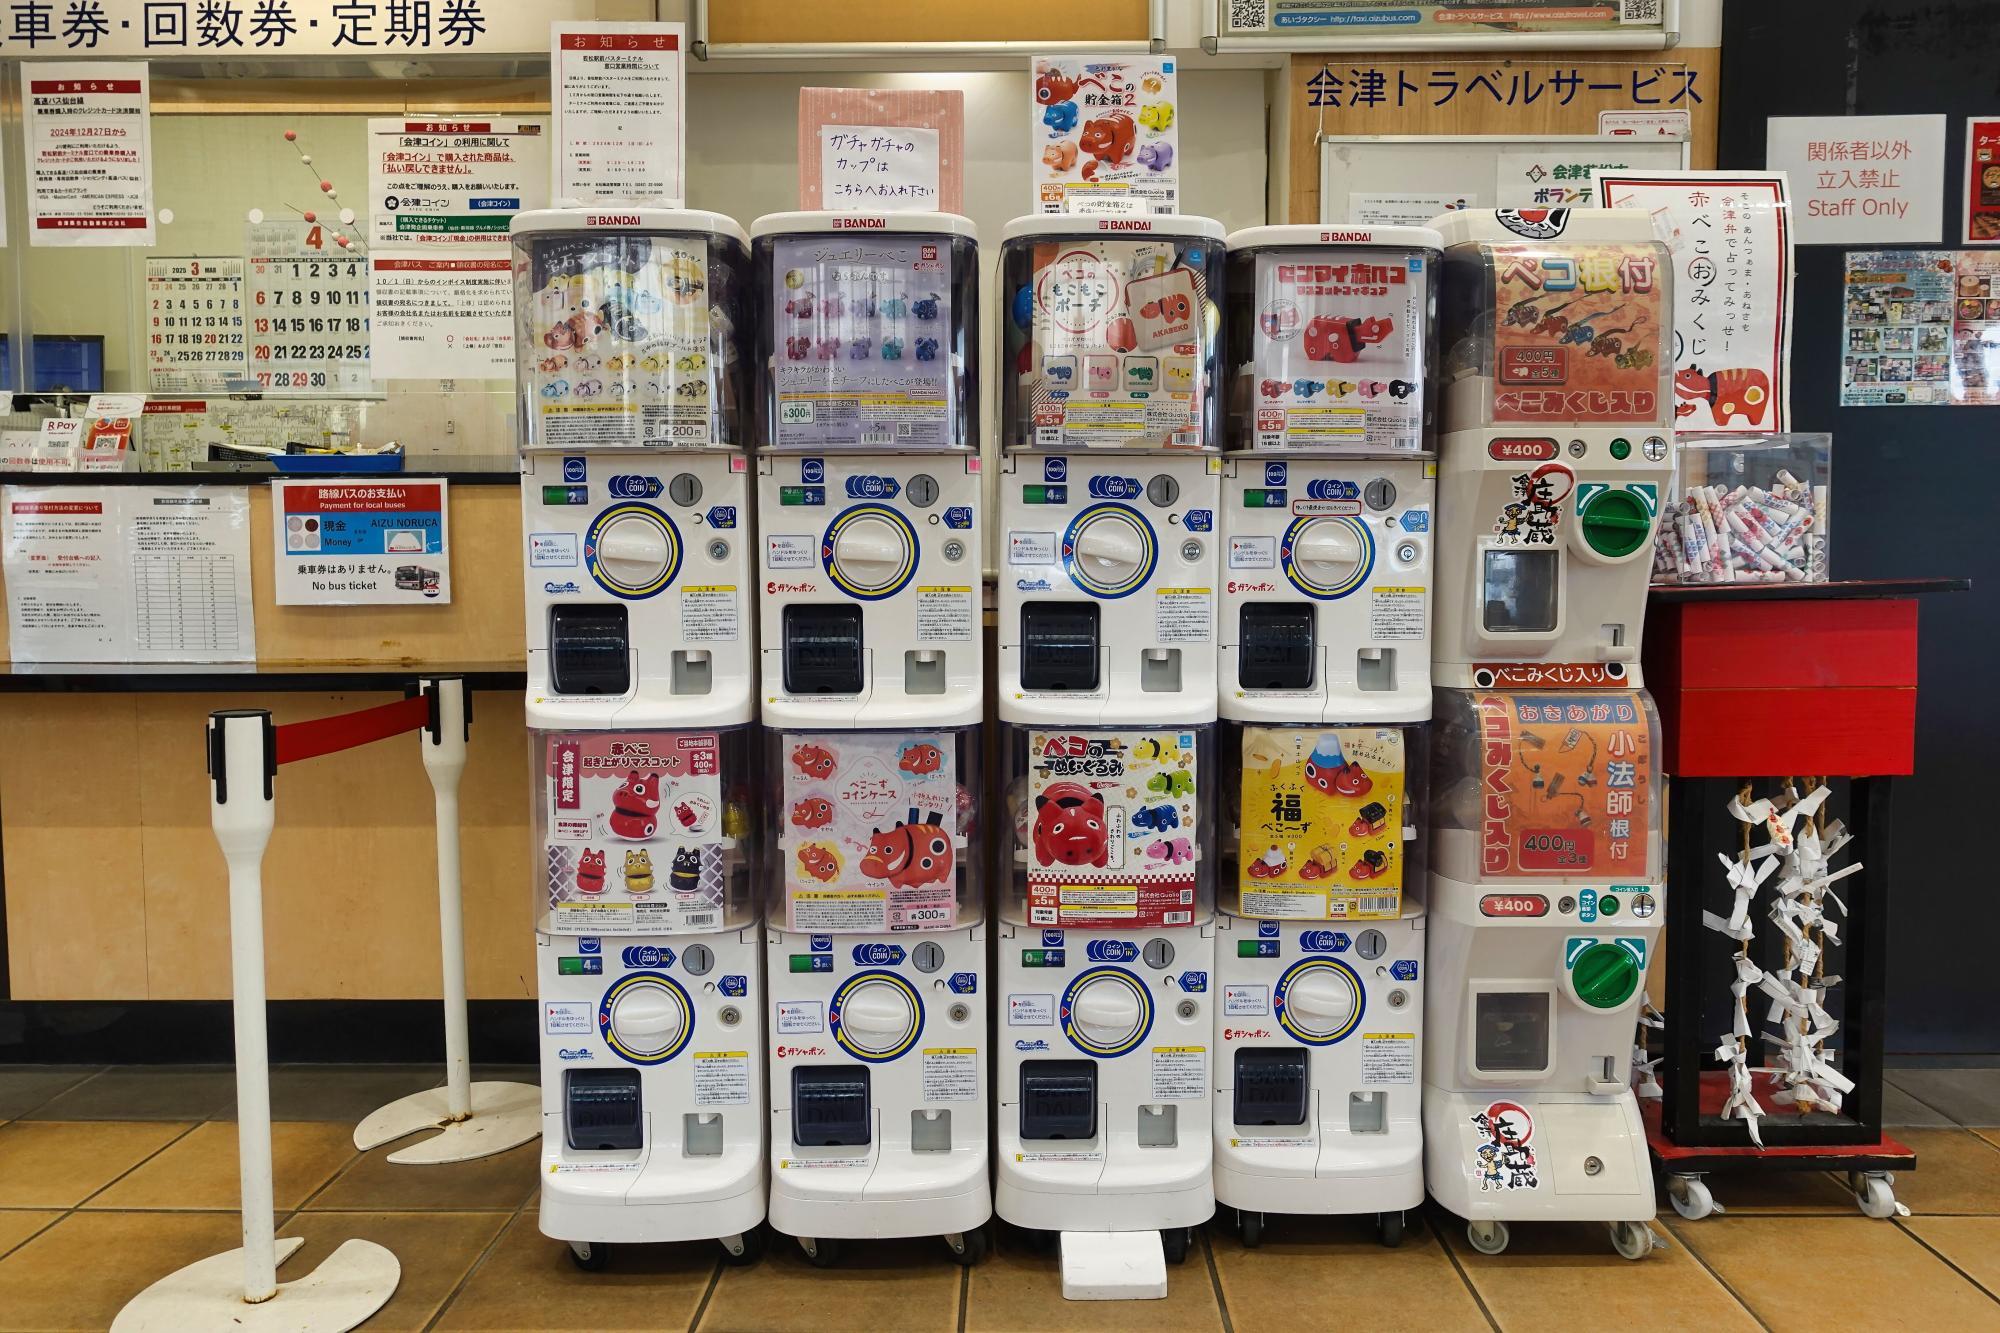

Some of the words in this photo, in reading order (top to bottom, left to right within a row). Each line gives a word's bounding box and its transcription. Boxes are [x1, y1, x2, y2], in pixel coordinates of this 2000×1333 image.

[1280, 16, 1326, 25] あいづタクシー
[1438, 11, 1504, 20] 会津トラベルサービス
[0, 0, 488, 48] 車券・回数券・定期券
[1079, 72, 1134, 93] べこの
[1305, 67, 1704, 109] 会津トラベルサービス
[33, 97, 84, 105] 高速バス仙台線
[1085, 94, 1136, 106] 貯金箱2
[50, 127, 127, 137] 2024年12月27日から
[400, 137, 510, 147] 「会津コイン」の利用に関して
[830, 133, 914, 152] ガチャガチャの
[1807, 140, 1912, 161] 関係者以外
[383, 152, 514, 162] 「会津コイン」で購入された商品は、
[383, 164, 473, 174] 「払い戻しできません」。
[837, 157, 889, 173] カップは
[1816, 170, 1900, 189] 立入禁止
[834, 182, 935, 197] こちらへお入れ下さい
[400, 197, 450, 207] 会津コイン
[1808, 198, 1855, 217] Staff
[1862, 198, 1909, 220] Only
[599, 215, 641, 226] BANDAI
[844, 218, 886, 228] BANDAI
[1110, 221, 1152, 231] BANDAI
[306, 226, 323, 250] 4
[1332, 232, 1372, 242] BANDAI
[814, 246, 908, 264] ジュエリーべこ
[191, 262, 200, 276] 3
[292, 264, 299, 277] 1
[310, 264, 320, 277] 2
[328, 264, 338, 277] 3
[347, 264, 357, 277] 4
[1278, 263, 1406, 285] ゼンマイ赤ベコ
[1501, 256, 1655, 294] ベコ根付
[1688, 191, 1716, 356] 赤べこおみくじ
[1720, 196, 1738, 352] 会津弁で占ってみっせ！
[1052, 283, 1108, 297] もこもこ
[256, 291, 265, 305] 6
[274, 291, 283, 305] 7
[292, 291, 302, 305] 8
[311, 291, 321, 305] 9
[326, 291, 341, 305] 10
[346, 291, 359, 305] 11
[1055, 299, 1102, 312] ポーチ
[255, 318, 269, 332] 13
[272, 318, 287, 332] 14
[291, 318, 305, 332] 15
[309, 318, 323, 332] 16
[327, 318, 341, 332] 17
[346, 318, 360, 332] 18
[1152, 323, 1189, 339] AKABEKO
[255, 346, 270, 360] 20
[274, 346, 288, 360] 21
[291, 346, 307, 360] 22
[309, 346, 325, 360] 23
[328, 346, 343, 360] 24
[346, 346, 362, 360] 25
[1515, 351, 1555, 363] 400円
[57, 421, 78, 431] Pay
[1502, 444, 1543, 456] ¥400
[318, 488, 406, 499] 路線バスのお支払い
[628, 484, 645, 492] COIN
[866, 484, 881, 492] COIN
[1108, 485, 1124, 493] COIN
[1326, 488, 1342, 496] COIN
[320, 502, 351, 510] Payment
[353, 501, 362, 509] for
[365, 501, 383, 509] local
[385, 501, 405, 509] buses
[324, 520, 347, 532] 現金
[371, 519, 394, 528] AIZU
[397, 519, 438, 528] NORUCA
[325, 539, 352, 548] Money
[297, 564, 392, 576] 乗車券はありません。
[312, 582, 325, 590] No
[328, 581, 346, 590] bus
[349, 581, 377, 590] ticket
[778, 583, 813, 592] ガシャポン
[1238, 583, 1272, 592] ガシャポン
[1494, 667, 1605, 683] べこみくじ入り
[1519, 704, 1633, 722] おきあがり
[610, 742, 650, 756] 赤べこ
[1042, 735, 1104, 759] ベコの
[583, 756, 681, 768] 起き上がりマスコット
[692, 752, 713, 761] 全3種
[1054, 758, 1125, 776] ぬいぐるみ
[561, 749, 575, 803] 会津限定
[1270, 783, 1305, 792] ふくふく
[842, 790, 897, 800] コインケース
[1606, 729, 1636, 860] 小法師根付
[1270, 792, 1302, 822] 福
[1524, 835, 1575, 852] 400円
[1494, 900, 1534, 912] ¥400
[641, 954, 658, 962] COIN
[1105, 948, 1121, 956] COIN
[1234, 1029, 1269, 1039] ガシャポン
[788, 1046, 823, 1056] ガシャポン
